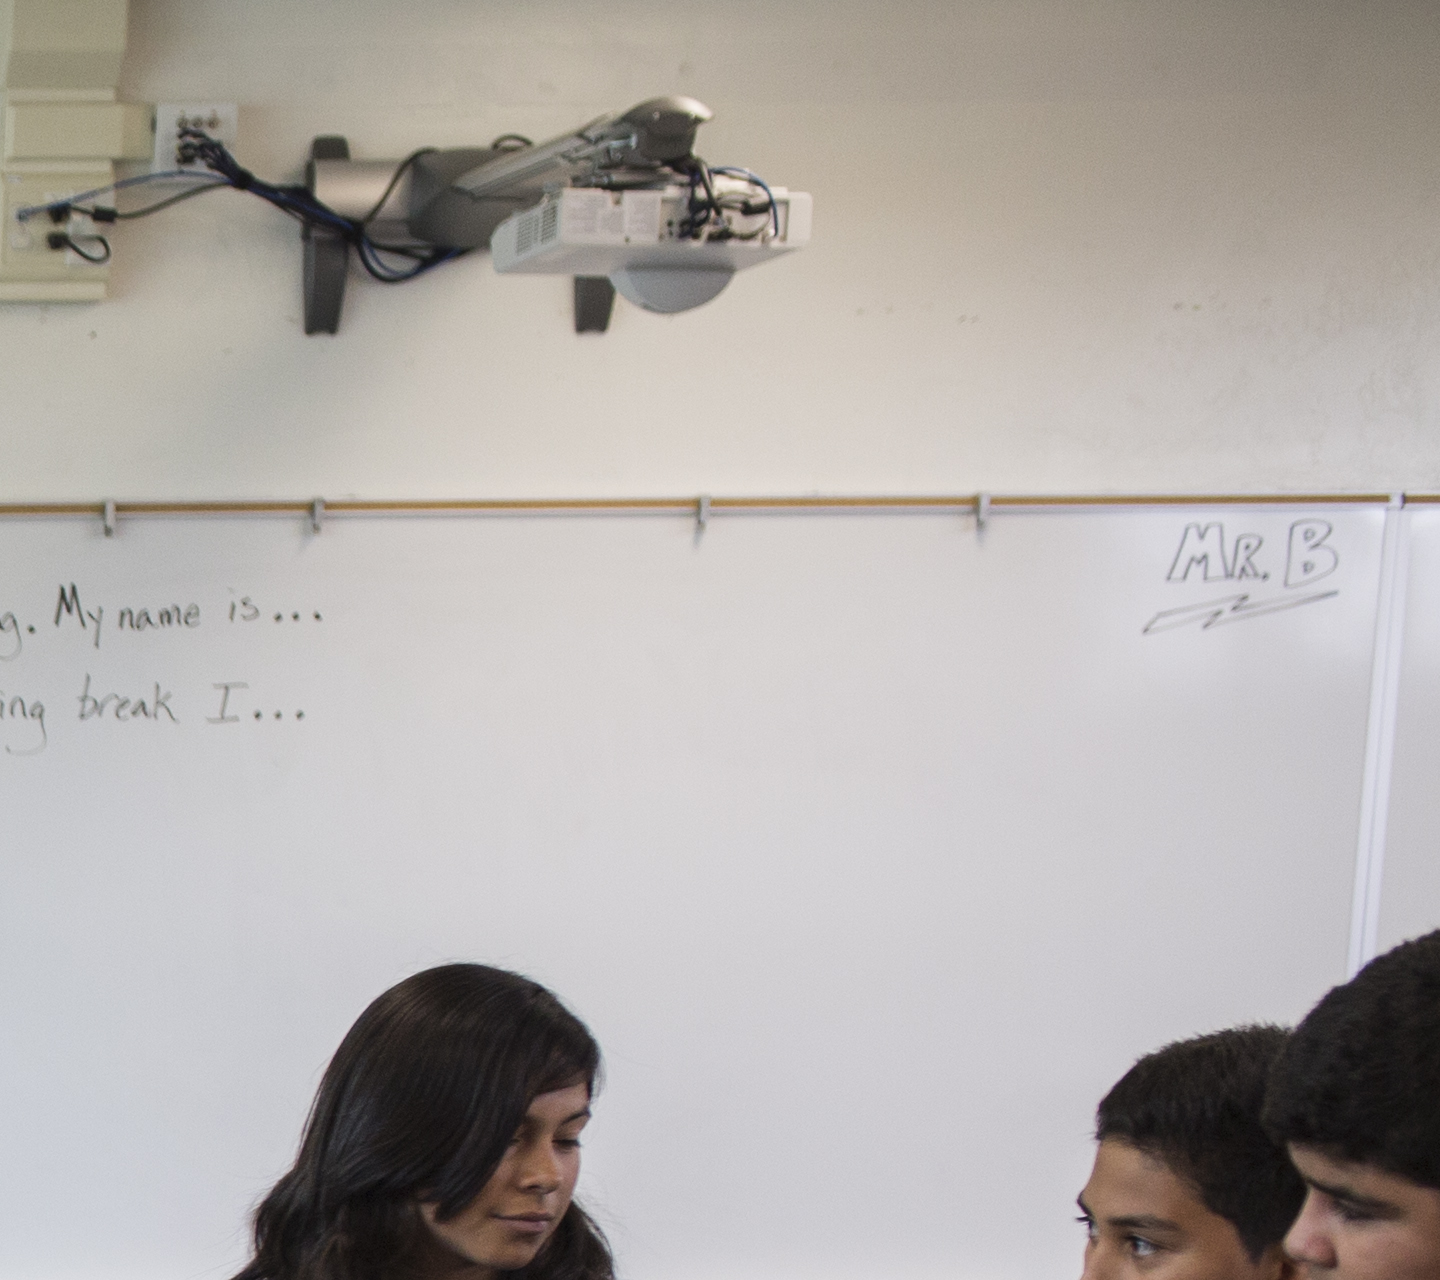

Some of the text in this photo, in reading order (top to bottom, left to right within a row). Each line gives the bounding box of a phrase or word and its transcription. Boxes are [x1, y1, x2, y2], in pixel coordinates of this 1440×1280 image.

[1283, 517, 1339, 588] B
[54, 582, 103, 649] My
[118, 603, 201, 631] name
[78, 674, 180, 725] break
